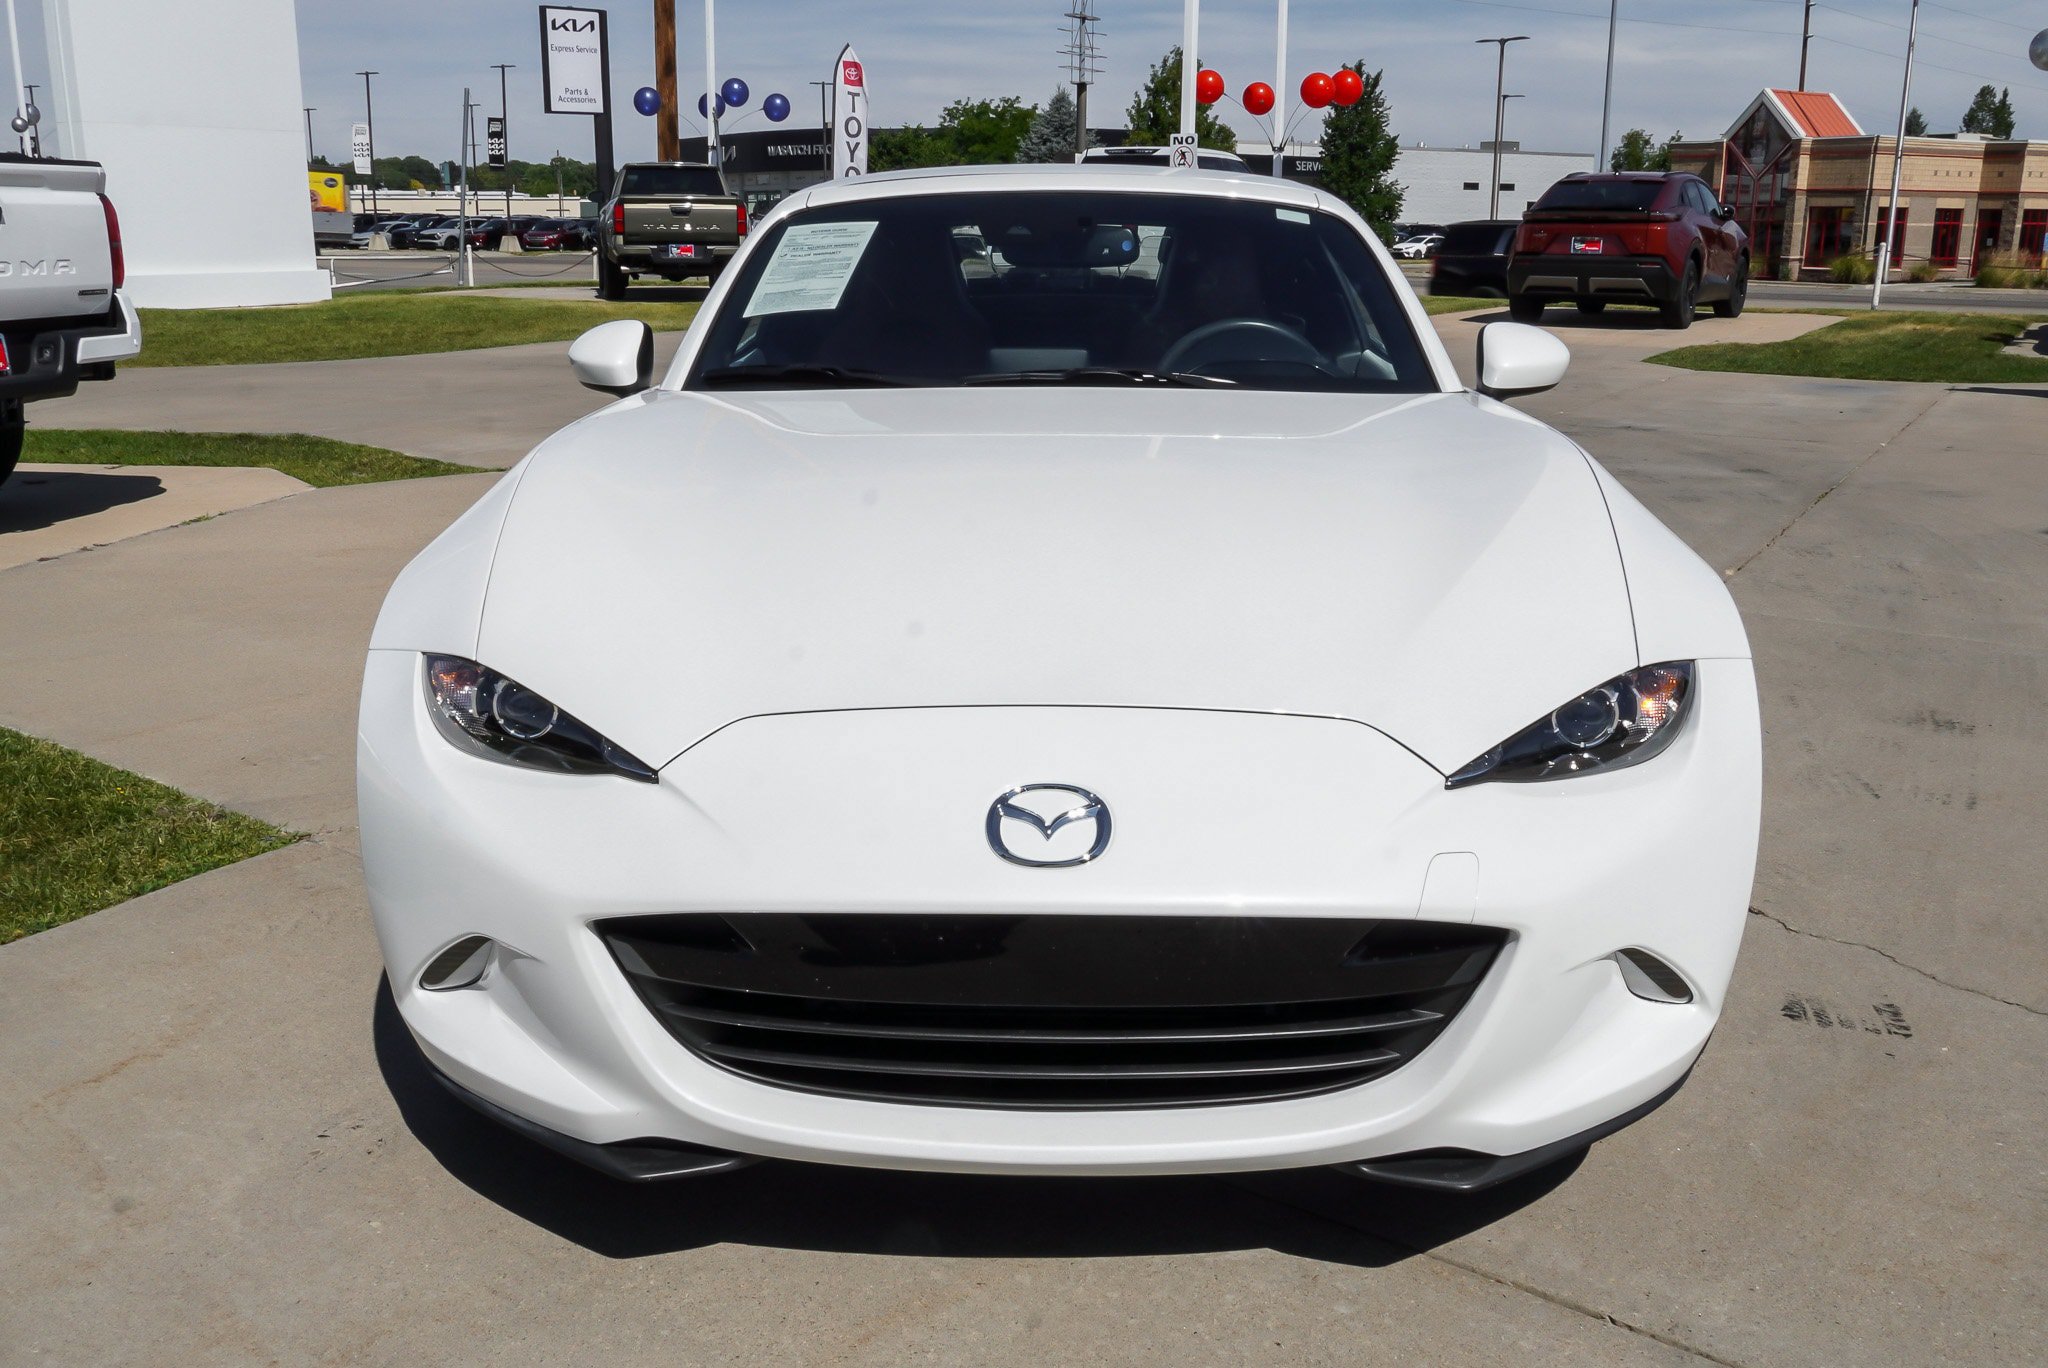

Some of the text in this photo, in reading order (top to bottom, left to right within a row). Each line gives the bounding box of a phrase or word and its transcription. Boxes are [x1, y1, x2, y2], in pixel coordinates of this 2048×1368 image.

[551, 18, 595, 32] KIA
[550, 44, 598, 54] Express Service
[564, 87, 589, 96] Parts &
[558, 95, 597, 104] Accessories
[1172, 136, 1195, 145] NO
[767, 145, 811, 157] WASATCH
